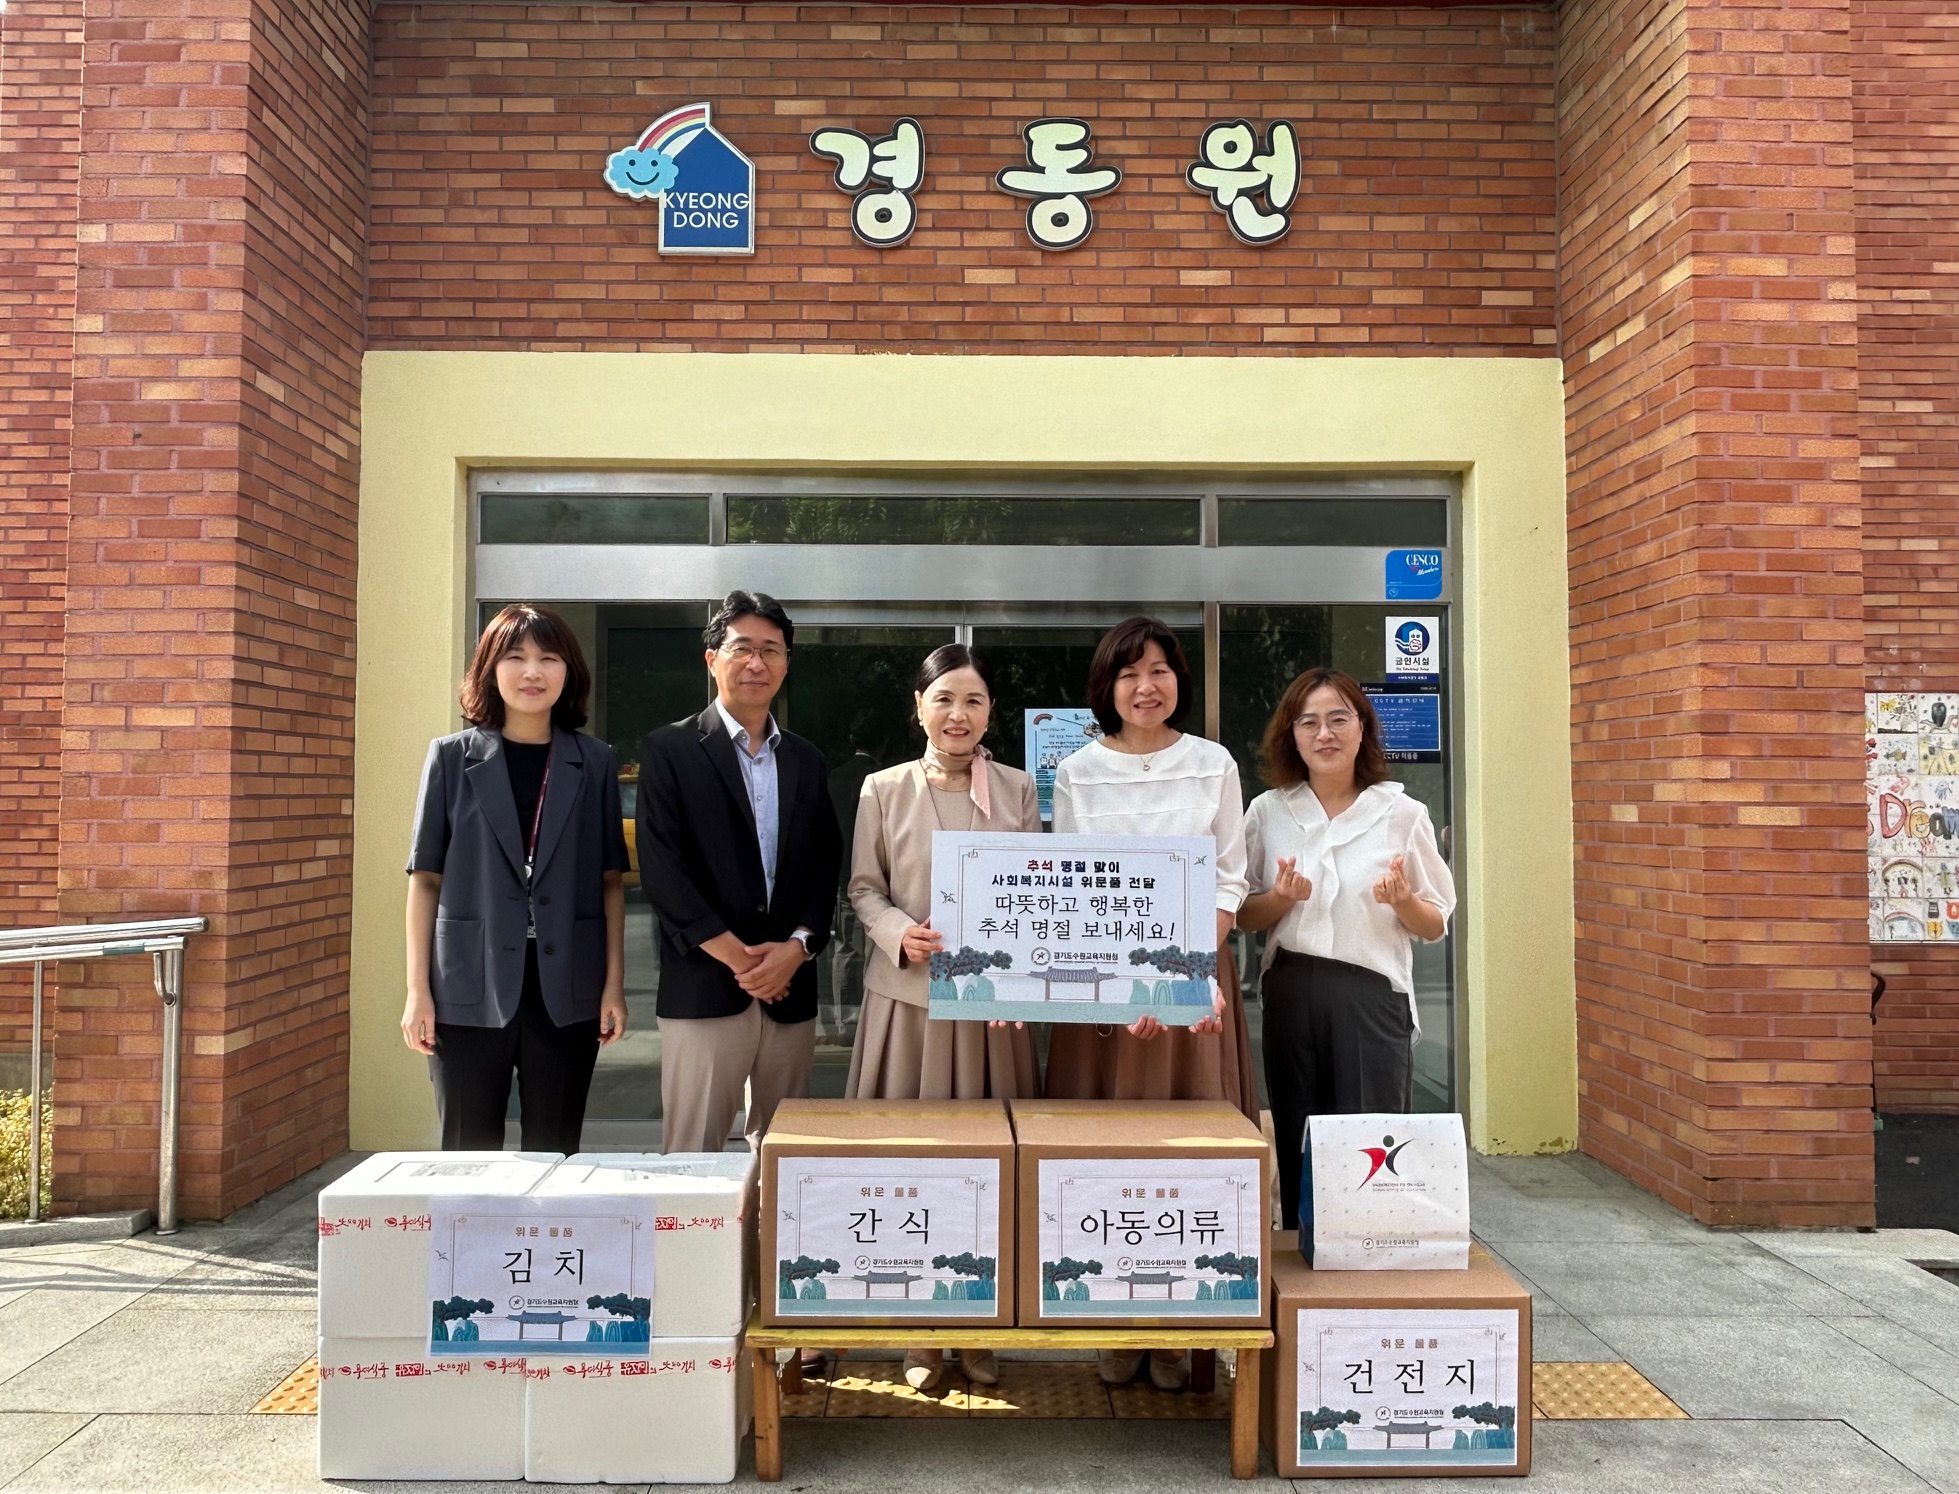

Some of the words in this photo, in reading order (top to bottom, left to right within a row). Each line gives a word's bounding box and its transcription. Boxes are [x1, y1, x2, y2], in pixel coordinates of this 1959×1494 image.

[808, 117, 1303, 252] 경동원
[664, 192, 750, 210] KYEONG
[673, 211, 739, 229] DONG
[1027, 859, 1053, 872] 추석
[1060, 860, 1087, 873] 명절
[1093, 861, 1120, 874] 맞이
[991, 874, 1074, 888] 사회복지시설
[1080, 876, 1122, 889] 위문품
[1128, 877, 1156, 890] 전달
[995, 893, 1080, 915] 따뜻하고
[1088, 895, 1154, 917] 행복한
[977, 917, 1020, 940] 추석
[1030, 918, 1071, 941] 명절
[1081, 920, 1176, 943] 보내세요!
[848, 1208, 930, 1245] 간식
[1080, 1209, 1225, 1246] 아동의류
[502, 1248, 584, 1286] 김치
[1343, 1359, 1476, 1395] 건전지
